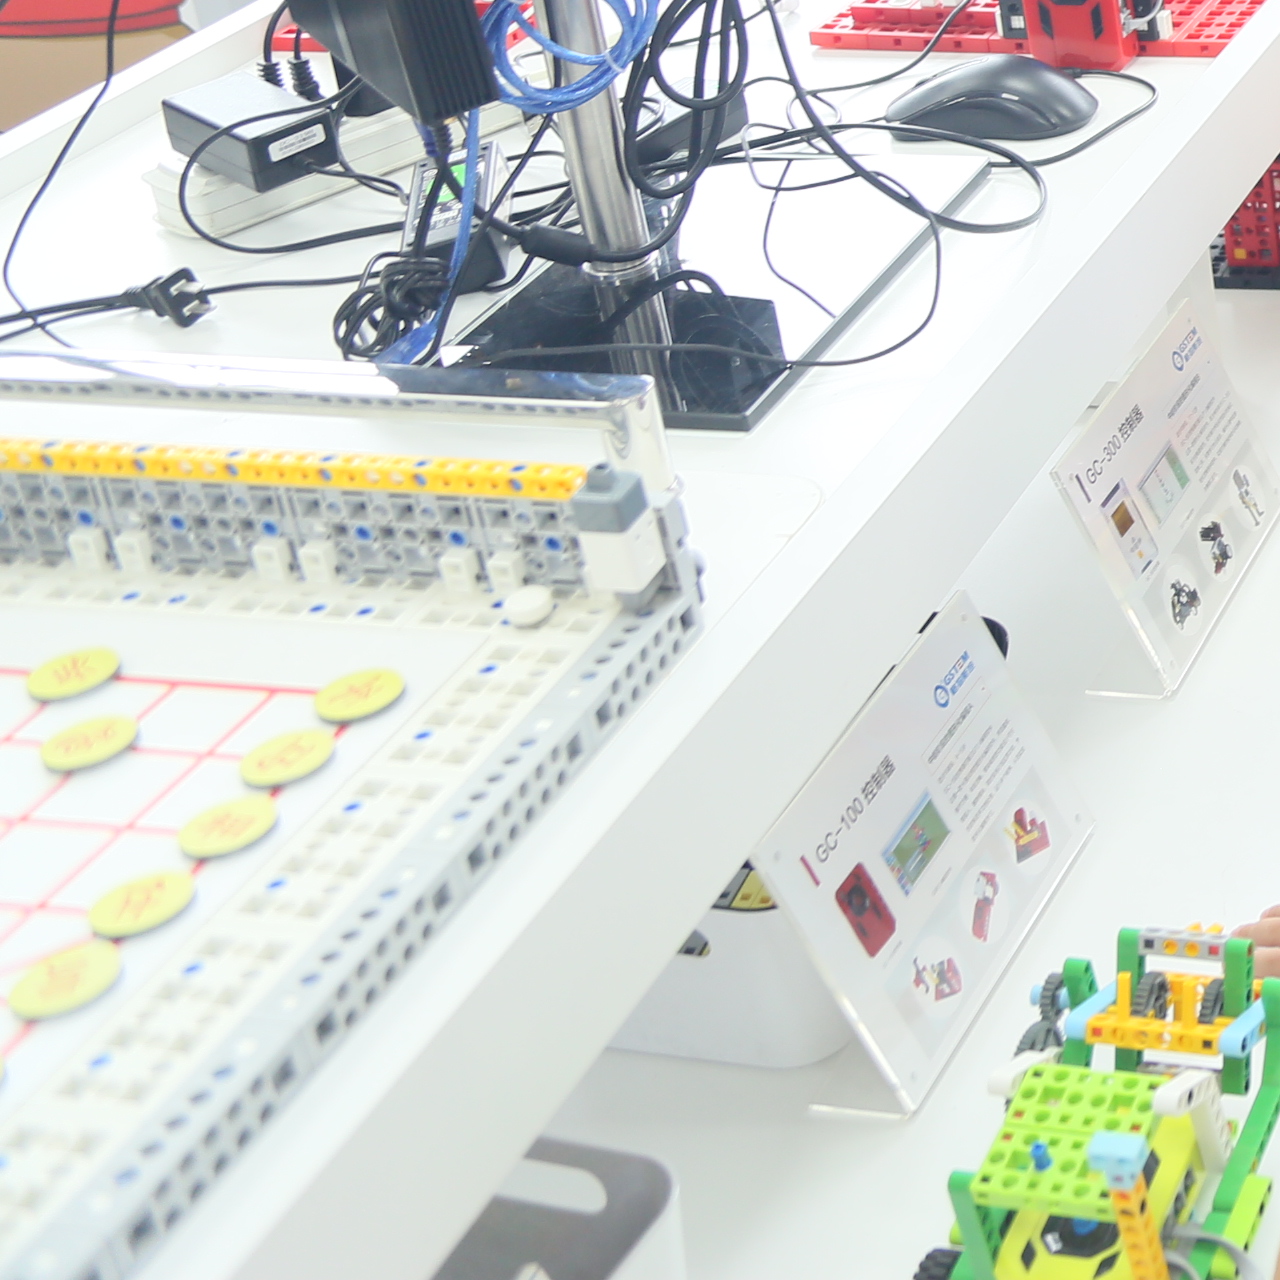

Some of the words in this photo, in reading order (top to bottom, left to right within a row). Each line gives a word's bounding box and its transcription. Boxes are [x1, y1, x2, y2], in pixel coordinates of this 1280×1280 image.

[1086, 435, 1121, 485] GC-300
[1117, 403, 1145, 443] 控制器
[816, 798, 865, 863] GC-100
[860, 754, 897, 805] 控制器
